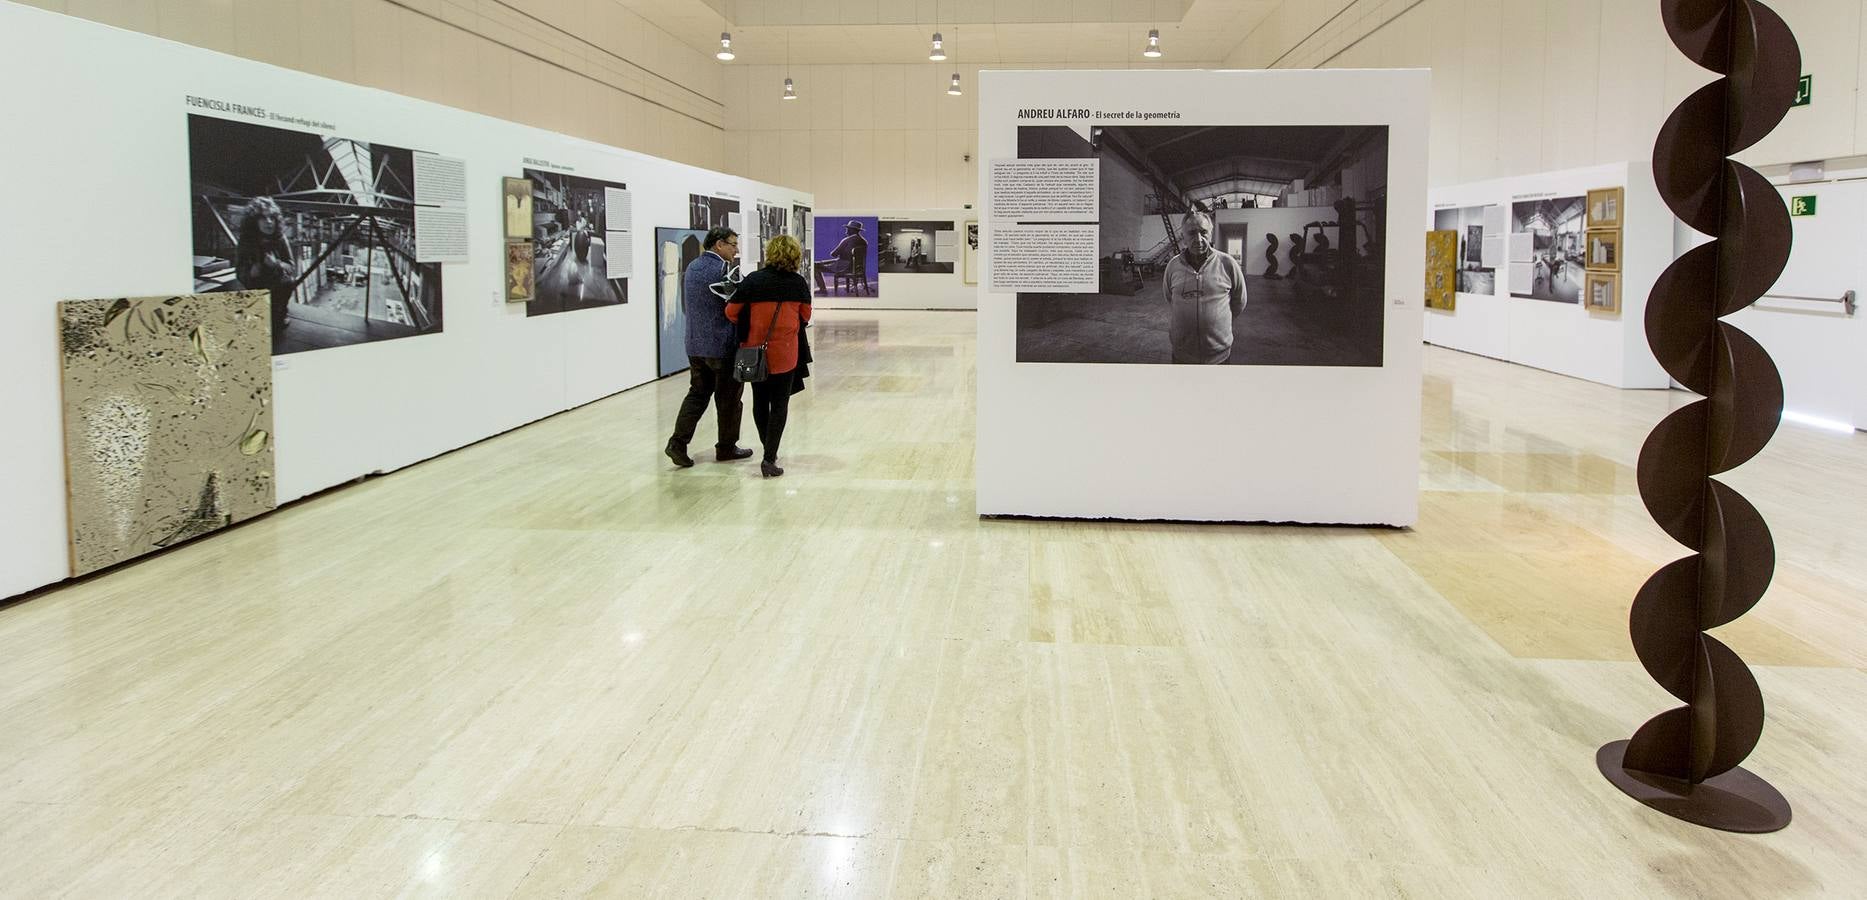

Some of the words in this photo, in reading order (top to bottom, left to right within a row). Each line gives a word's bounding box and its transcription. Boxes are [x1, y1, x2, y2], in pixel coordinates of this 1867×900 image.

[186, 95, 230, 112] FUENCISLA
[1018, 109, 1054, 119] ANDREU
[1056, 109, 1090, 119] ALFARO
[1095, 110, 1102, 119] El
[1103, 111, 1125, 119] secret
[1125, 110, 1134, 119] de
[1135, 110, 1142, 119] la
